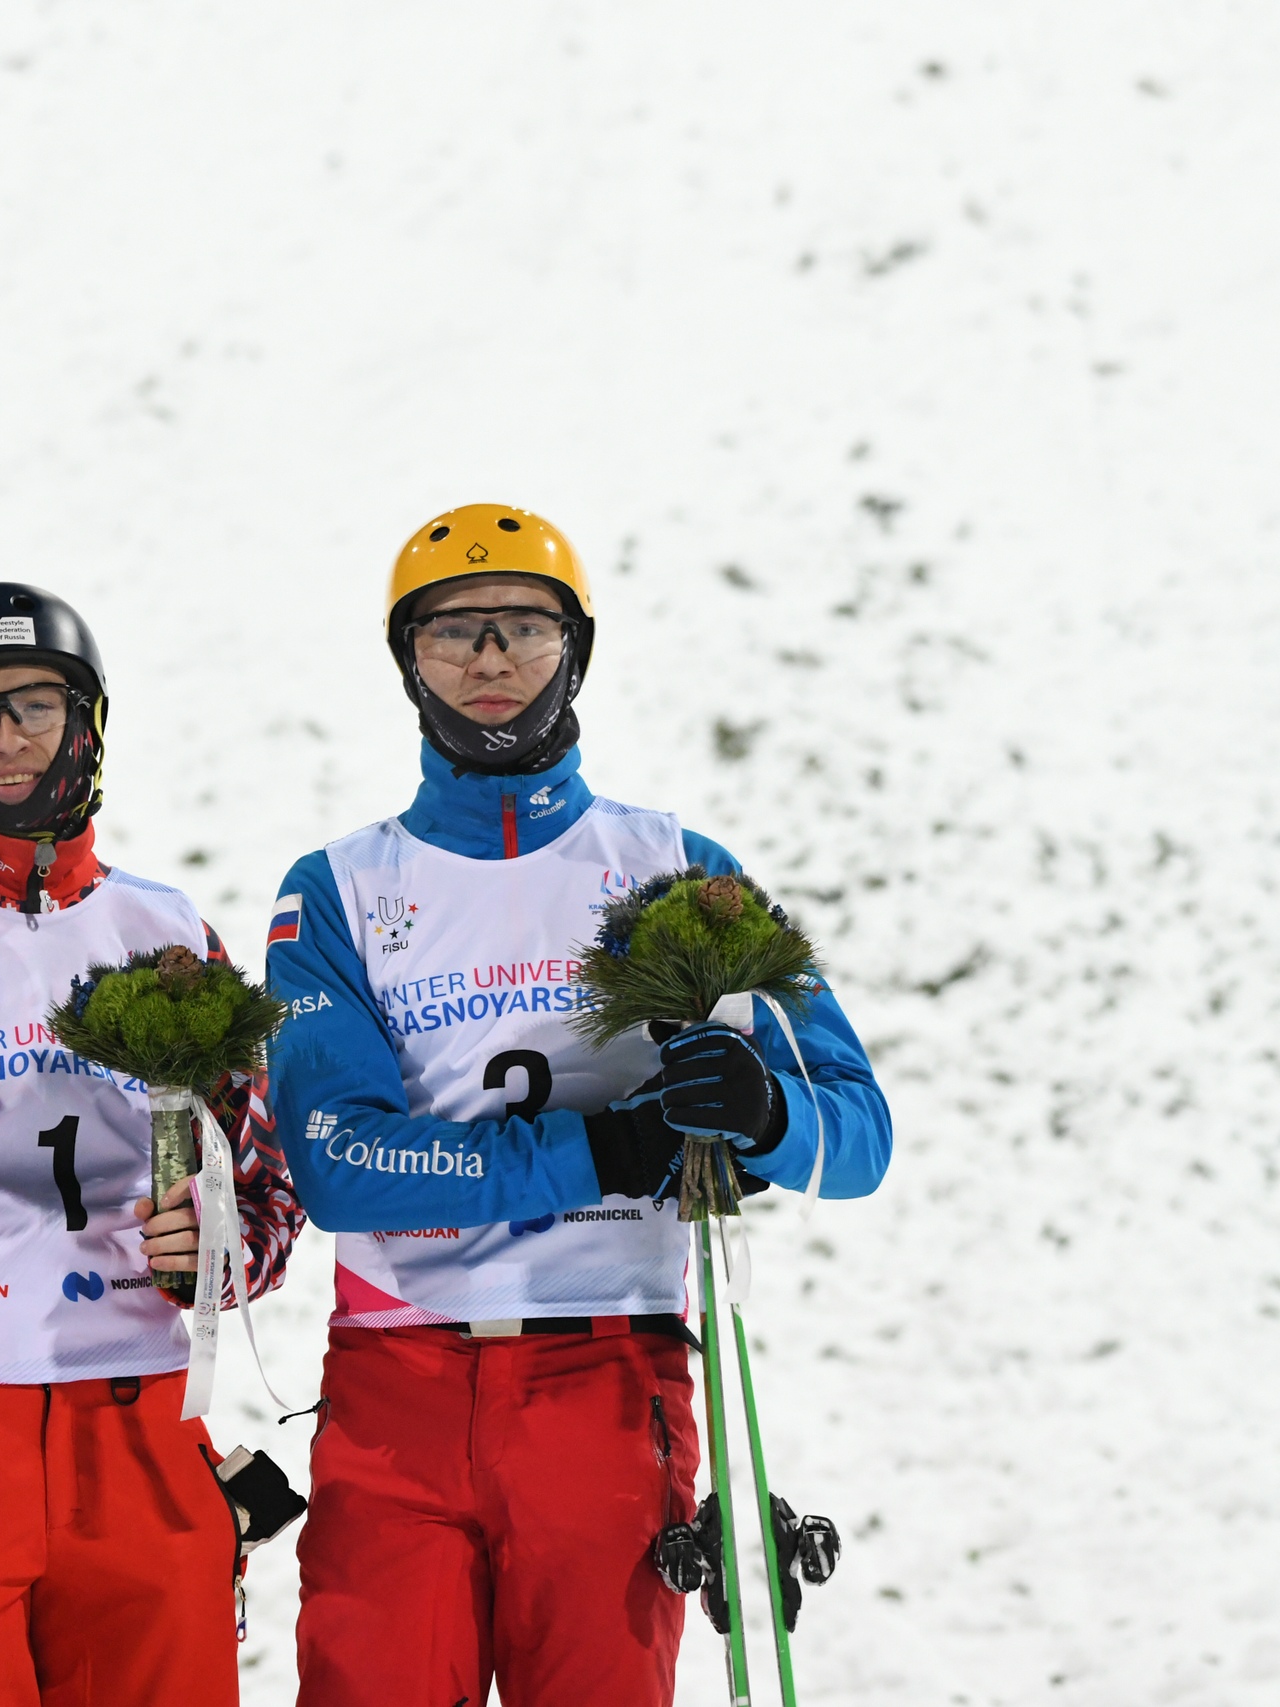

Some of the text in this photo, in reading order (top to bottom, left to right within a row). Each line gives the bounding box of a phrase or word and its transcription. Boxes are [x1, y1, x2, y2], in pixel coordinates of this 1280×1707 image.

[529, 798, 566, 820] Columbia
[382, 940, 409, 955] FISU
[378, 960, 588, 1010] INTER UNIVER
[386, 987, 597, 1038] RASNOYARSK
[483, 1049, 552, 1124] 3
[37, 1115, 88, 1231] 1
[325, 1127, 484, 1179] Columbia
[563, 1208, 643, 1223] NORNICKEL
[111, 1276, 153, 1290] NORNIC
